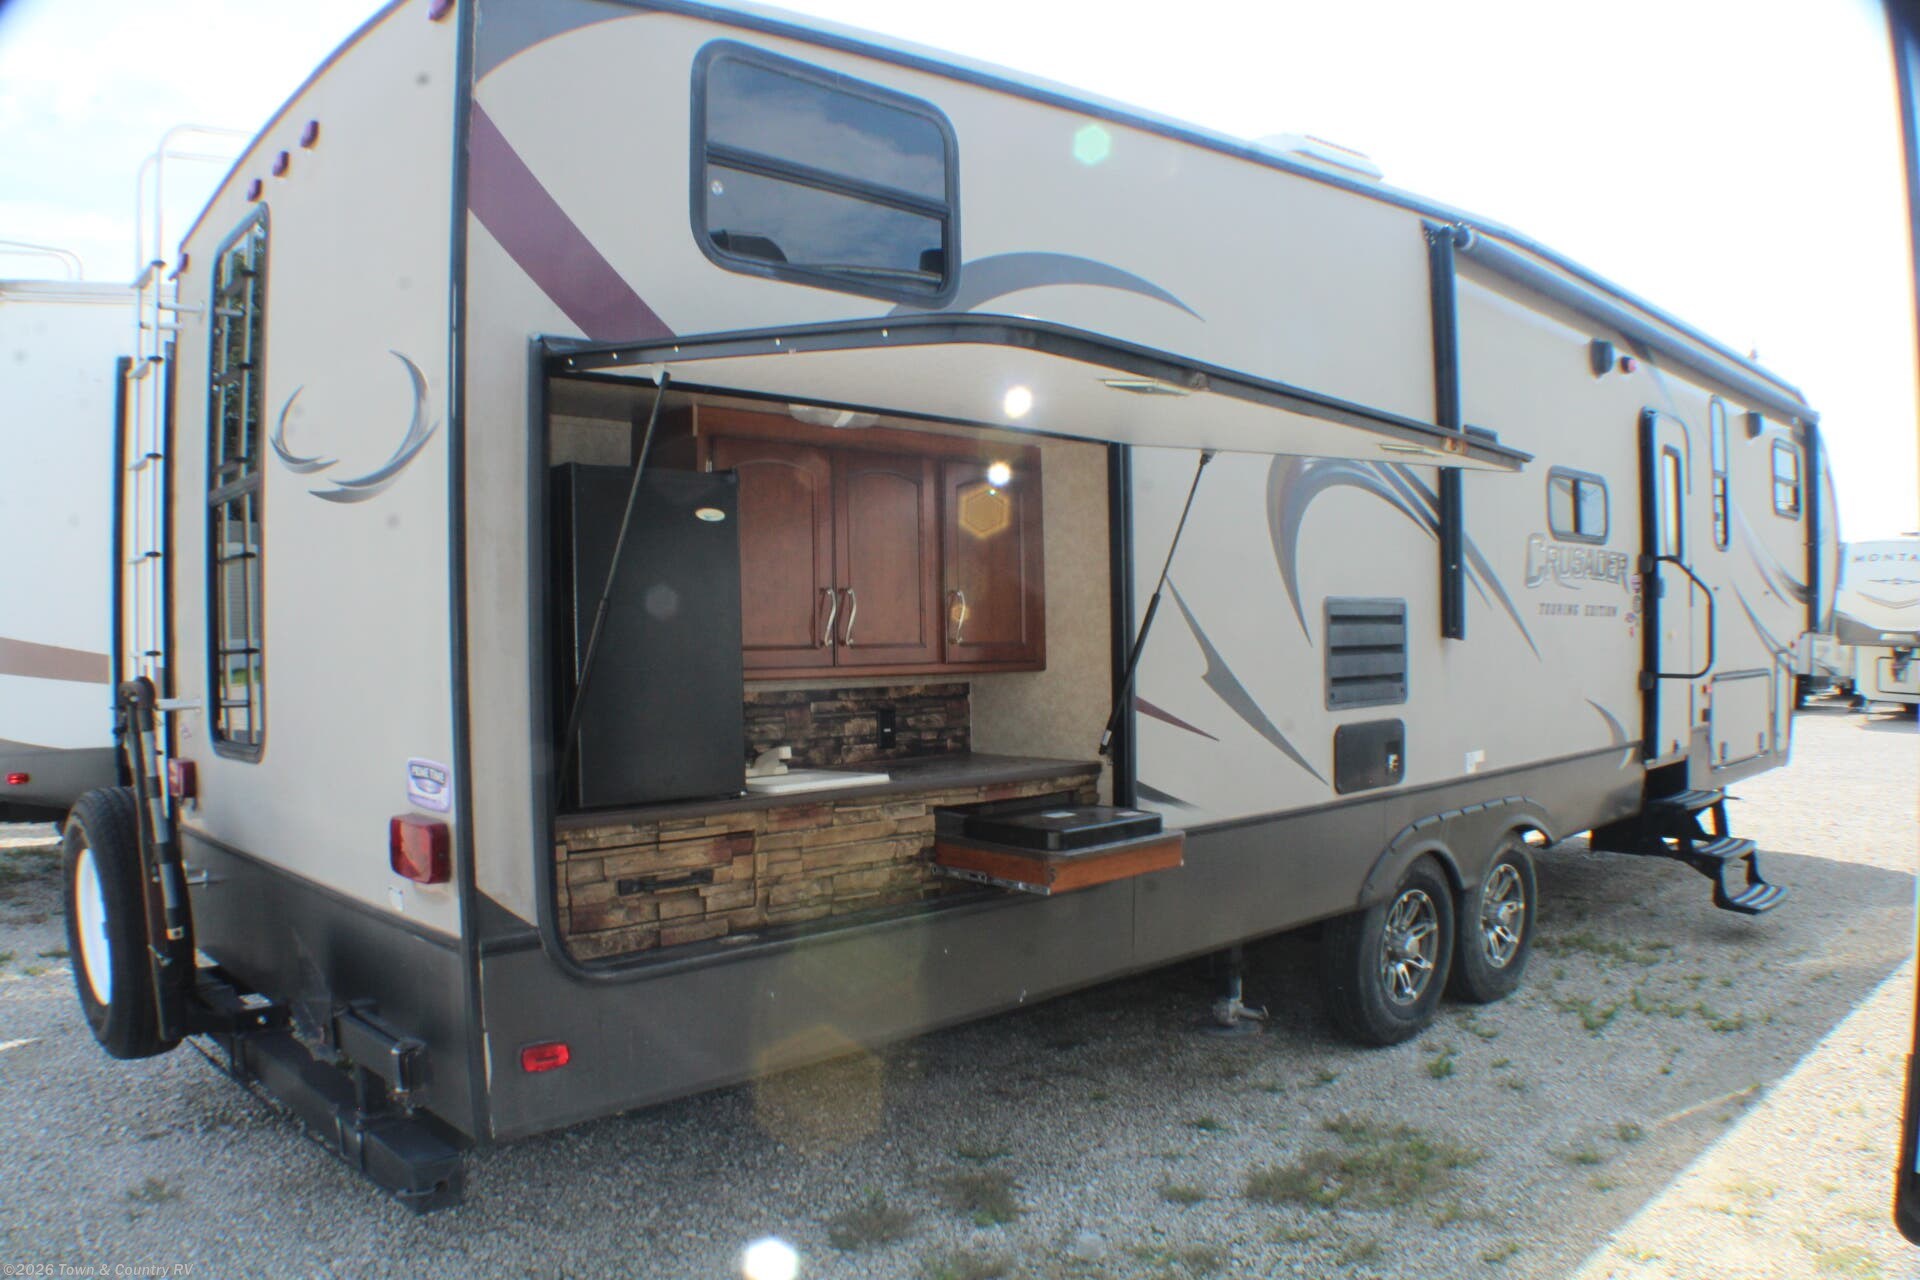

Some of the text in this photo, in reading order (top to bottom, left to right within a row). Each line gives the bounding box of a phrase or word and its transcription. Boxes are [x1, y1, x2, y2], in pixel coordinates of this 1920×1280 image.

[1525, 532, 1630, 593] CRUSADER
[1539, 603, 1618, 617] TOURING EDITION
